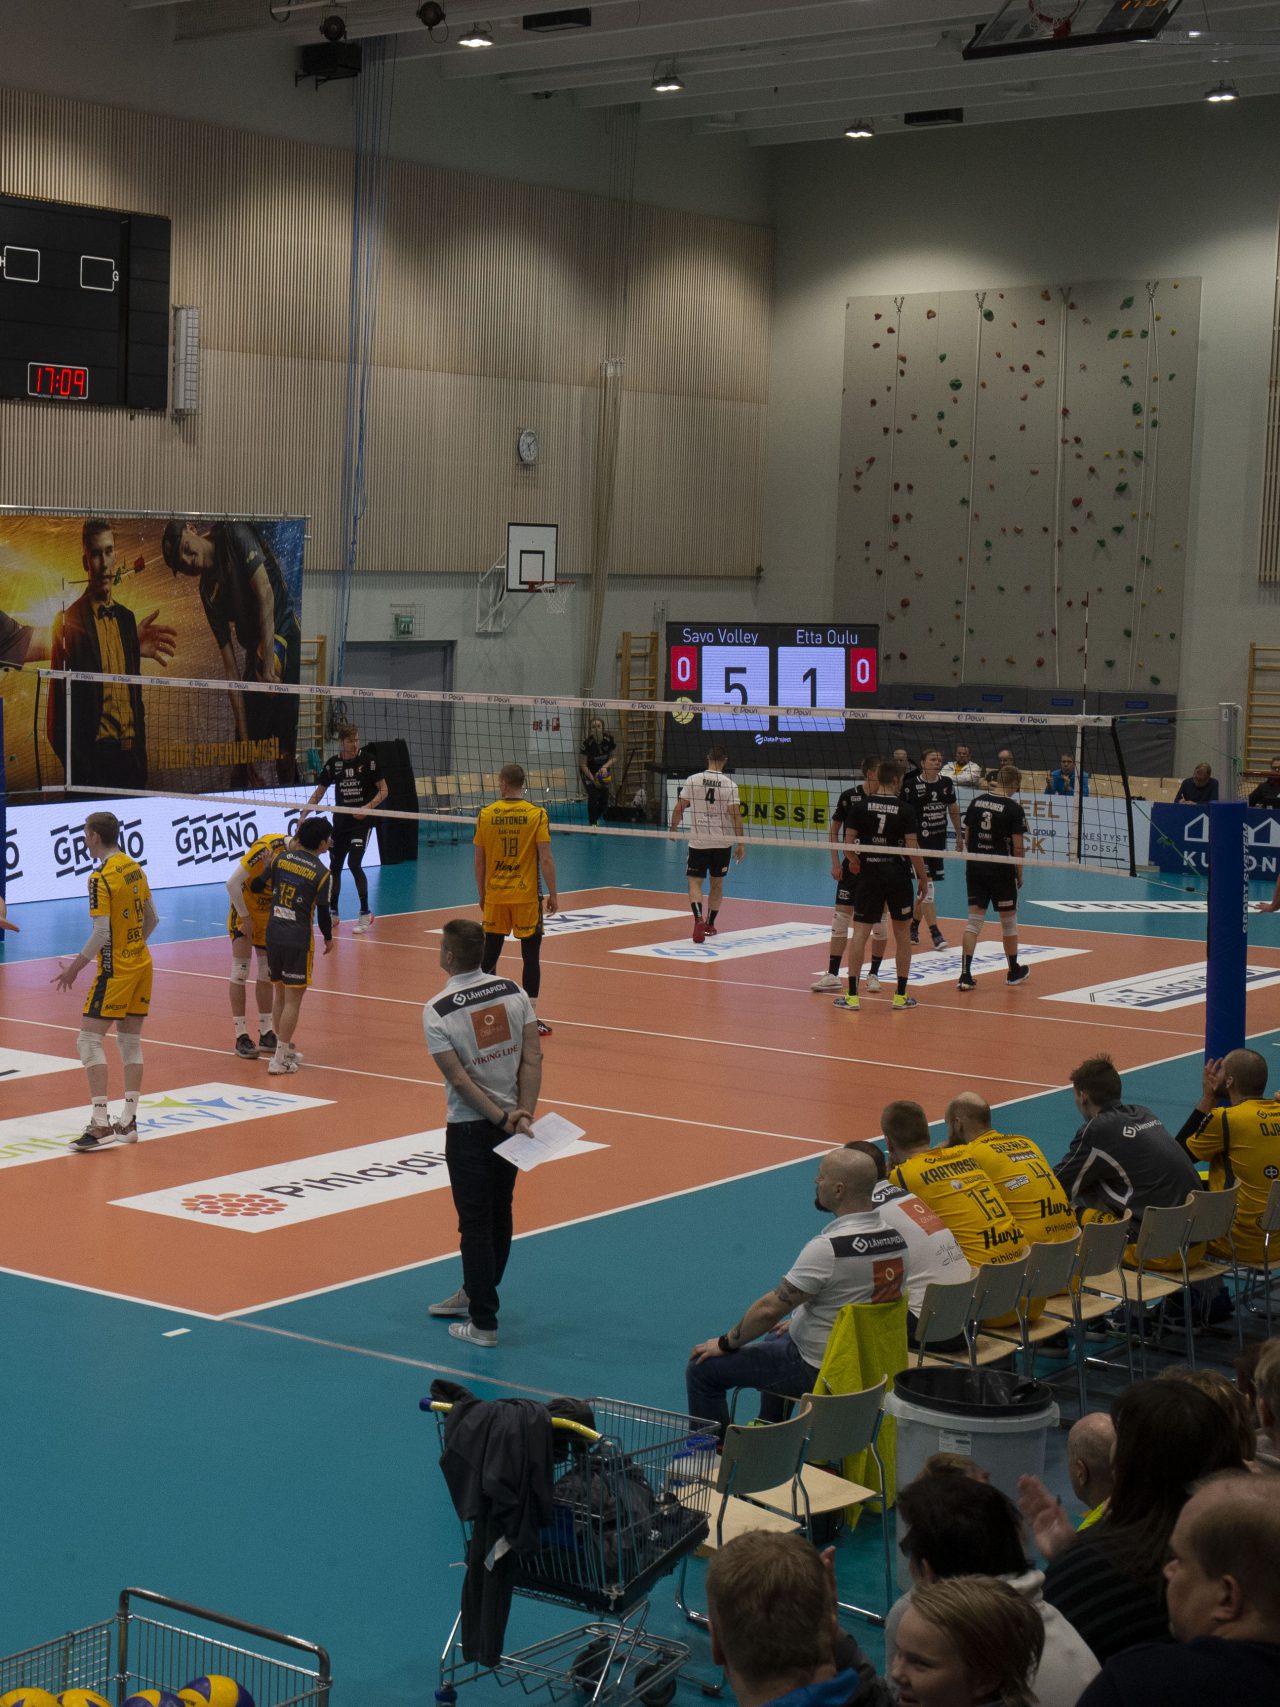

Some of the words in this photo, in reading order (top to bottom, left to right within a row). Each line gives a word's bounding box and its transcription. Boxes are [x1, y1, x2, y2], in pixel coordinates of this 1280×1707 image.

[0, 256, 6, 268] H
[113, 270, 120, 282] G
[36, 366, 86, 398] 17:09
[682, 627, 715, 644] Savo
[717, 627, 759, 645] Volley
[796, 629, 823, 645] Etta
[827, 629, 859, 646] Oulu
[677, 656, 692, 683] 0
[856, 658, 871, 685] 0
[802, 667, 818, 707] 1
[705, 788, 716, 804] 4
[931, 792, 938, 802] 2
[490, 815, 529, 826] LEHTONEN
[980, 811, 993, 831] 3
[54, 829, 144, 865] GRNO
[175, 819, 259, 855] GRANO
[500, 838, 519, 858] 18
[277, 859, 317, 881] KAWAGUCHI
[280, 883, 297, 909] 12
[1242, 884, 1250, 934] SPORT
[472, 1050, 502, 1067] VIKING
[1027, 1161, 1055, 1190] 4
[967, 1186, 1006, 1222] 15
